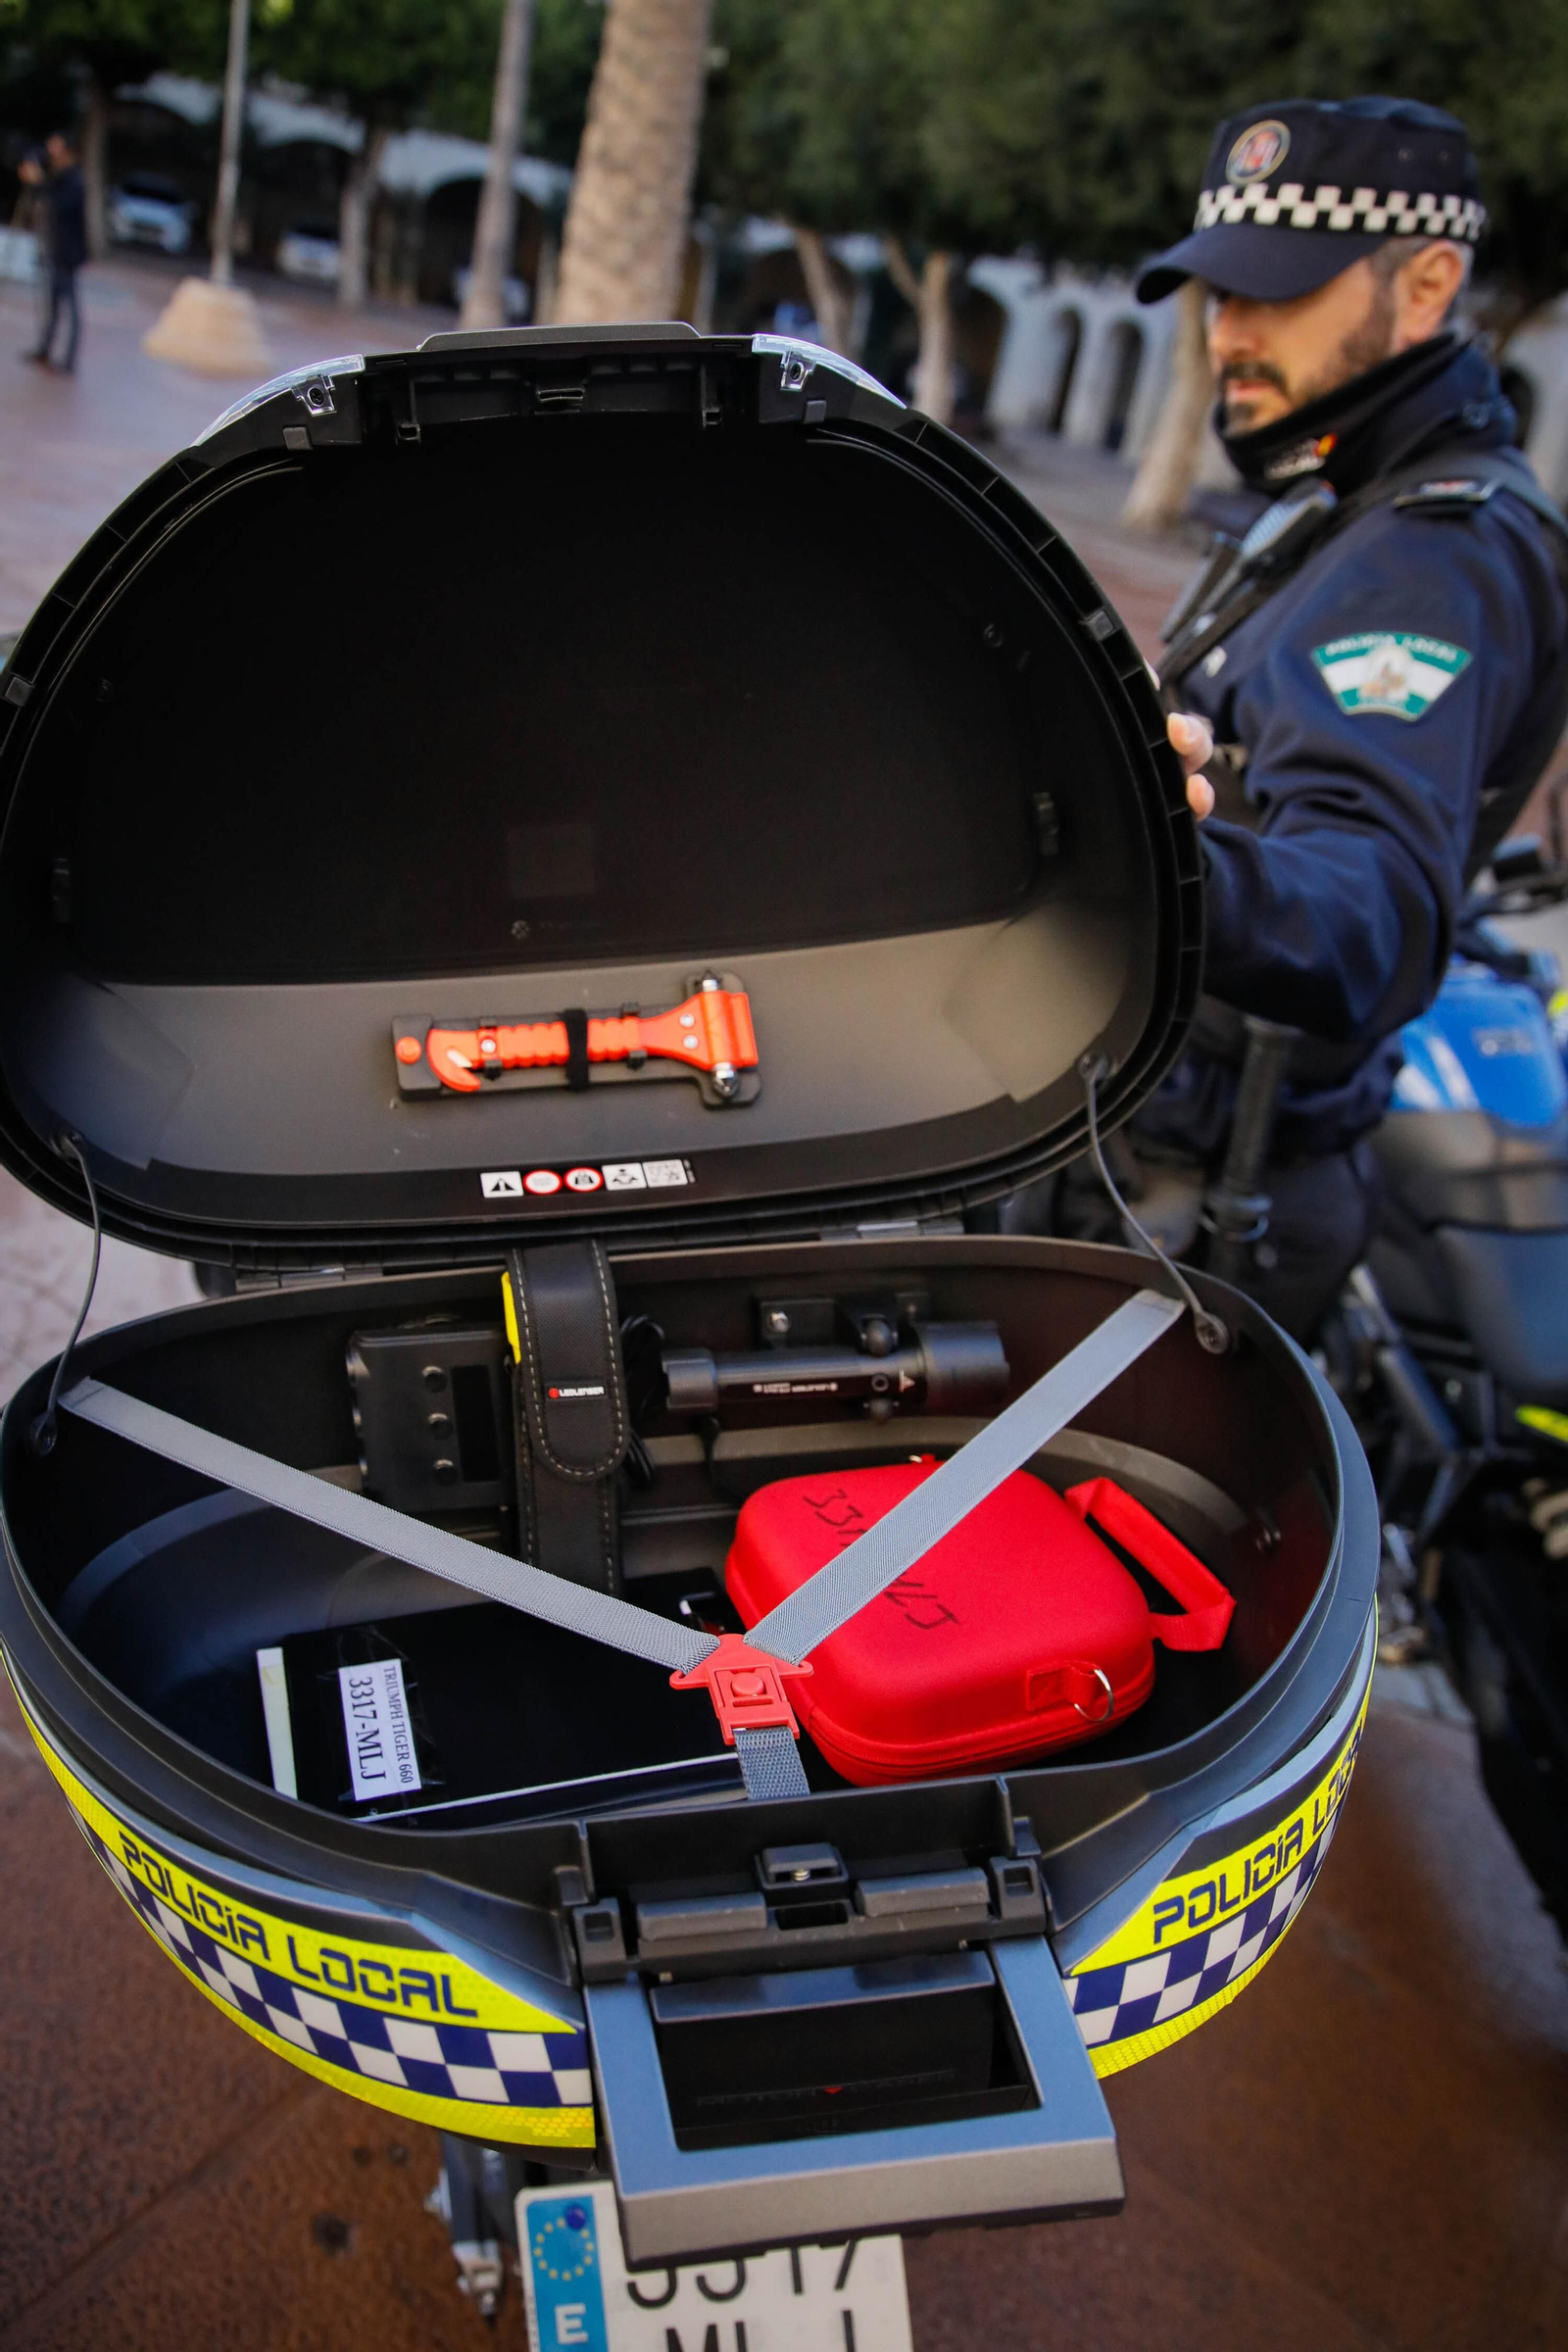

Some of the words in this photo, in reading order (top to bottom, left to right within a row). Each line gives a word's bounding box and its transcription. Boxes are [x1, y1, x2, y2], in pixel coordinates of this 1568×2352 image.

[383, 1665, 404, 1720] TRIUMPH
[349, 1676, 386, 1781] 3317-MLJ
[392, 1720, 411, 1762] TIGER
[399, 1764, 414, 1784] 660
[288, 1935, 478, 2018] LOCAL
[555, 2304, 588, 2344] E
